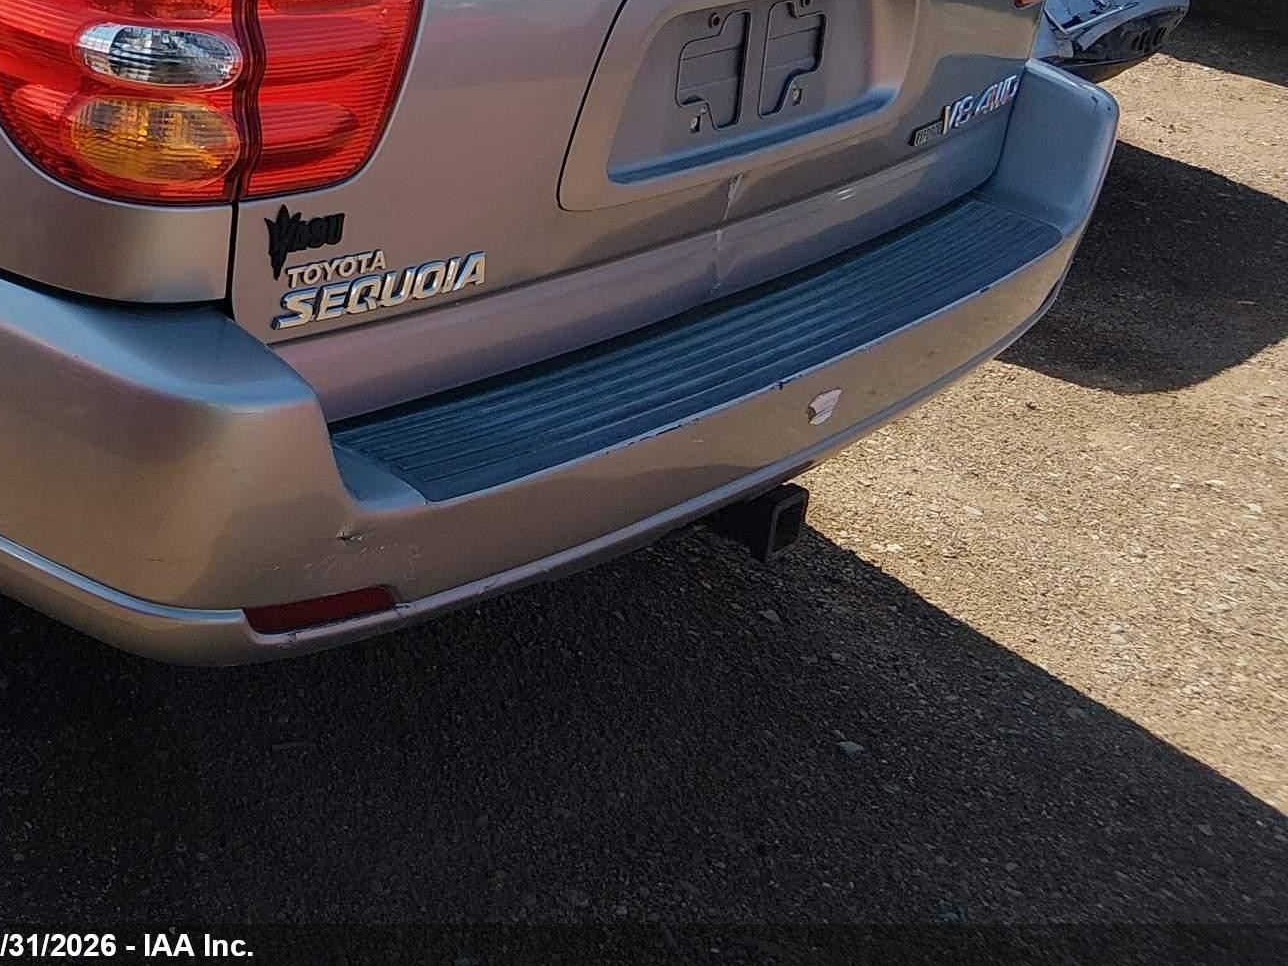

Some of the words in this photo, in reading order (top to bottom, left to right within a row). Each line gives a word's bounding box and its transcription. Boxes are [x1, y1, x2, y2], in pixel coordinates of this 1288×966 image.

[939, 95, 974, 135] V8
[287, 249, 387, 290] TOYOTA
[270, 250, 488, 331] SEQUOIA
